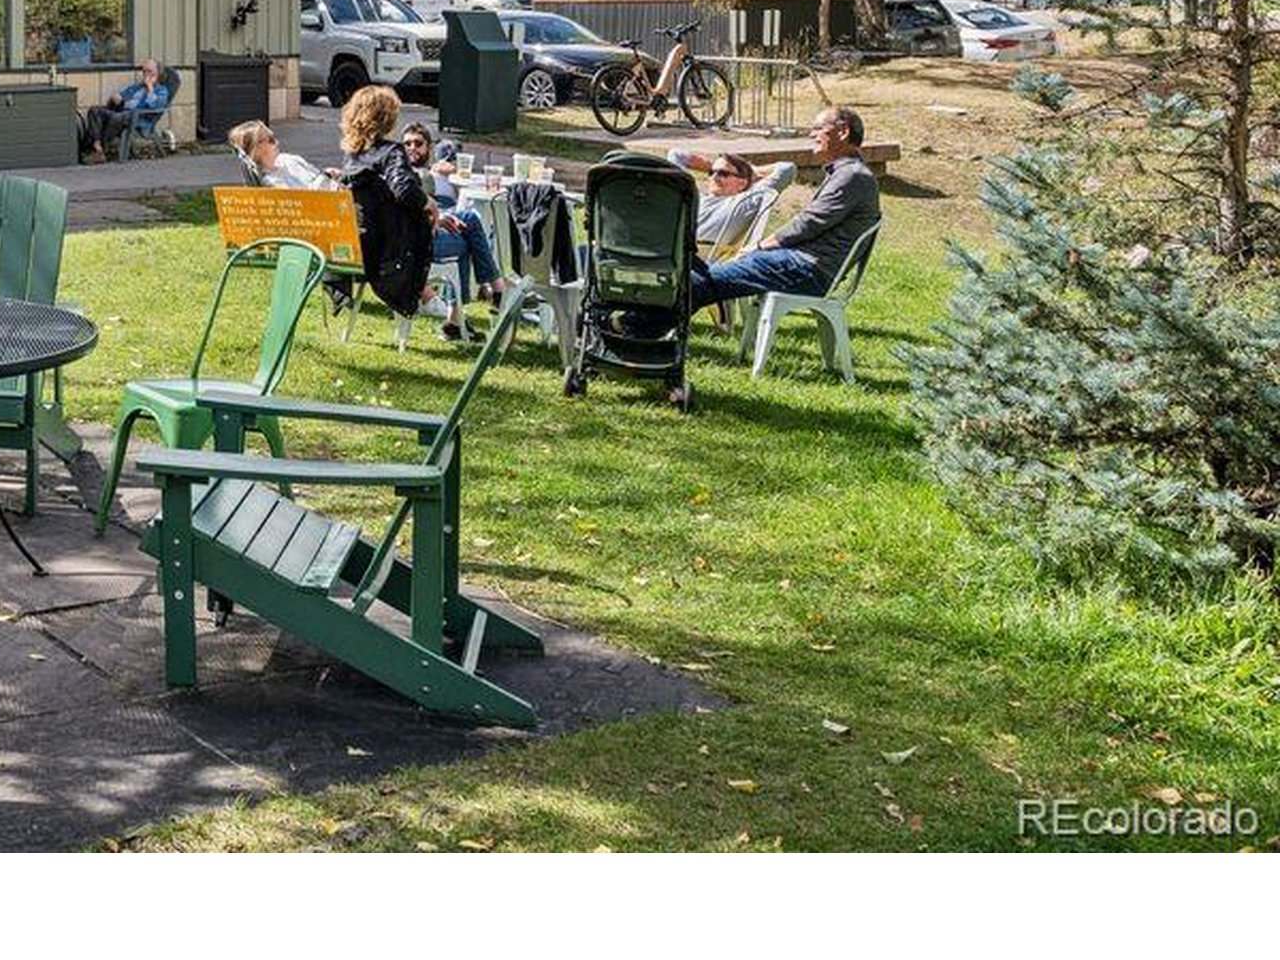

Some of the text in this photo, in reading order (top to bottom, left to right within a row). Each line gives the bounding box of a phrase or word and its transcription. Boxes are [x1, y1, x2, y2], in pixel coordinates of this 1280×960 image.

[221, 196, 303, 209] What do you
[259, 206, 275, 216] of
[276, 207, 302, 217] this
[224, 217, 341, 228] space and others?
